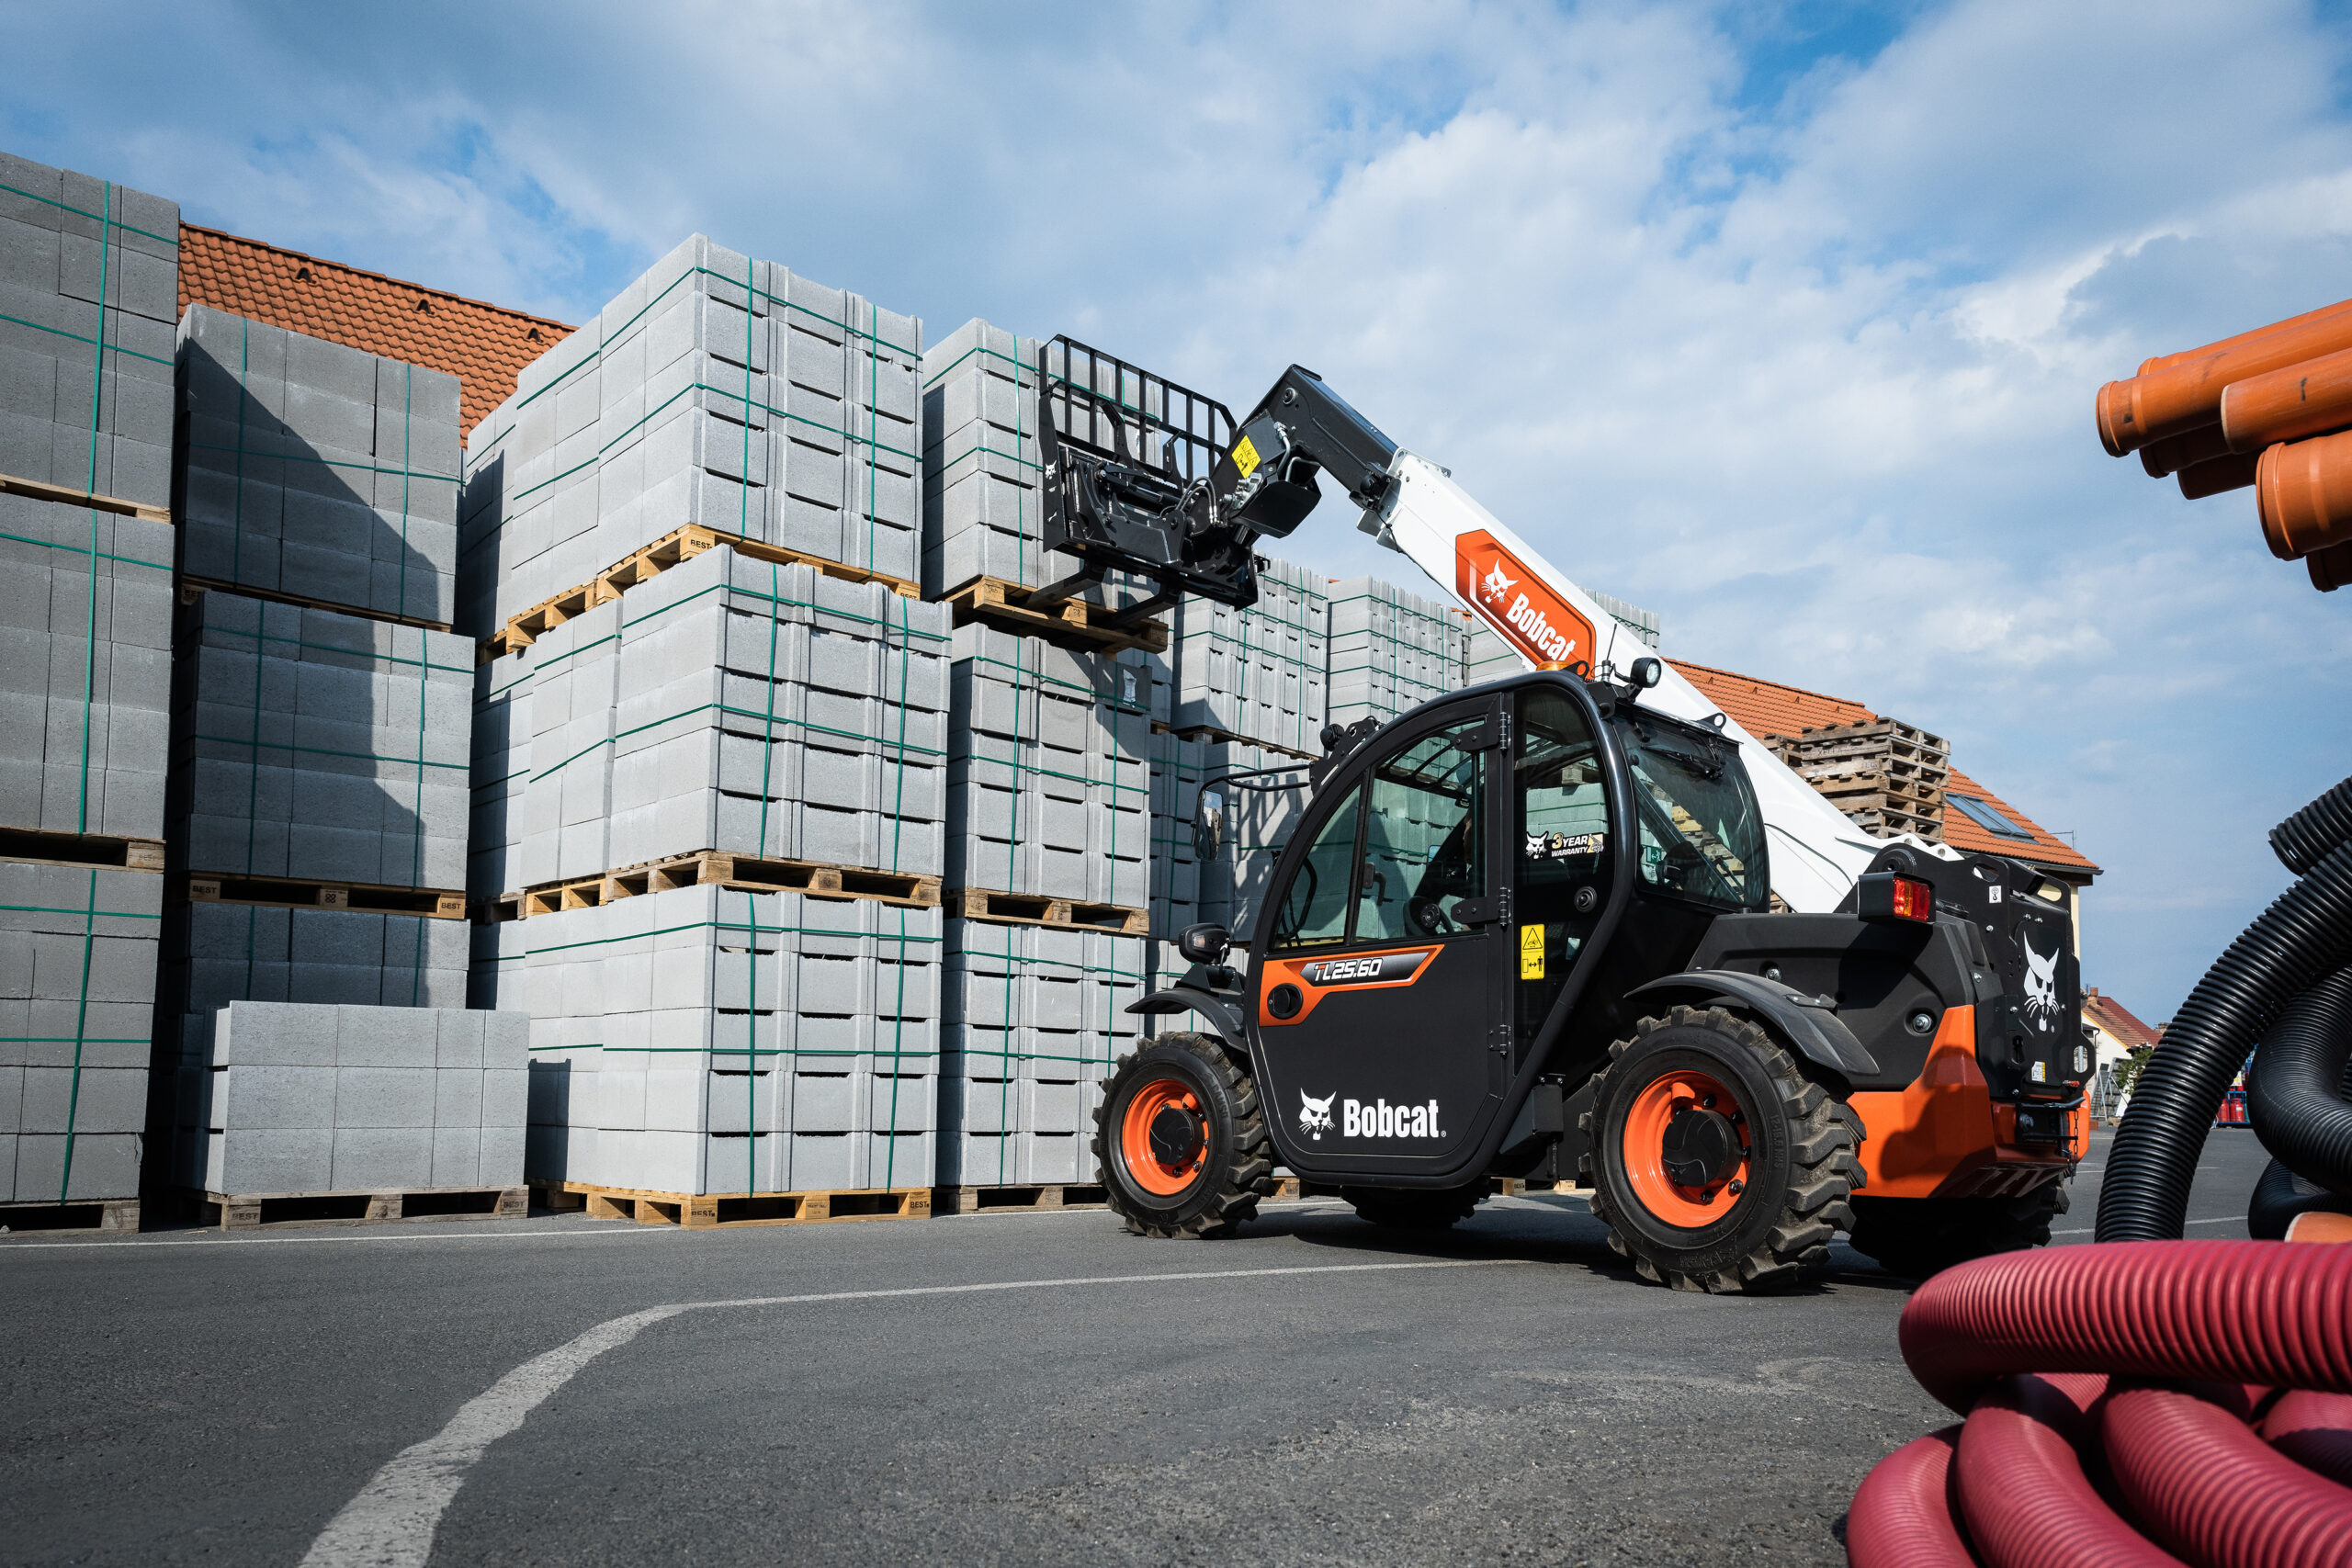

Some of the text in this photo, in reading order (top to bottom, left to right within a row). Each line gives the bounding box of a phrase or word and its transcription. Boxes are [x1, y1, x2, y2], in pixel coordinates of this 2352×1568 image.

[1506, 592, 1576, 661] Bobcat
[1551, 832, 1589, 849] 3 YEAR
[1551, 846, 1589, 857] WARRANTY
[192, 886, 217, 894] BEST
[1314, 958, 1383, 981] TL25.60
[1343, 1098, 1440, 1138] Bobcat
[232, 1213, 258, 1221] BEST
